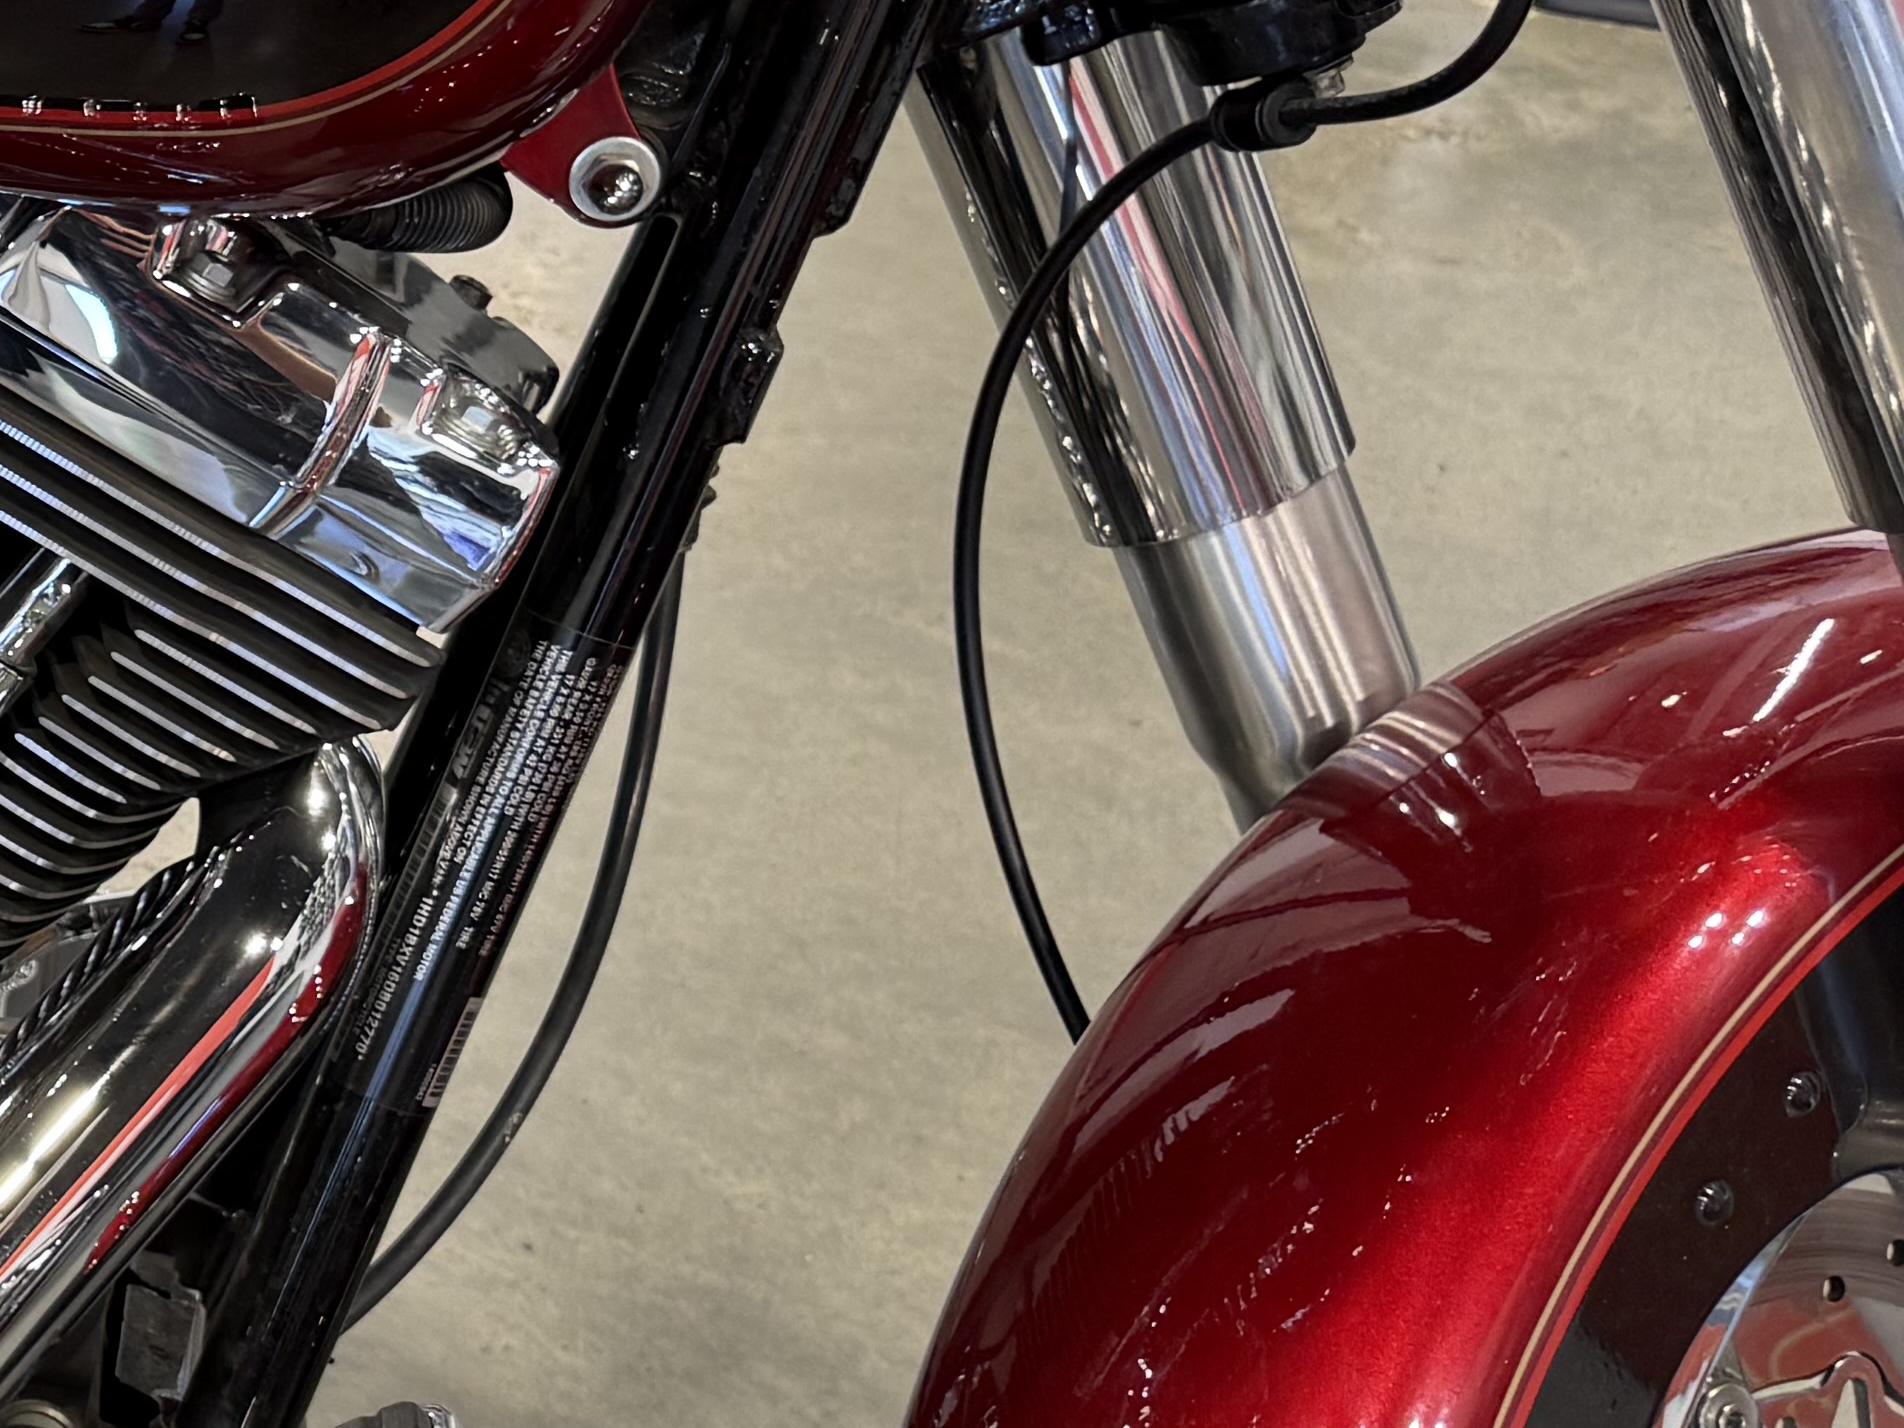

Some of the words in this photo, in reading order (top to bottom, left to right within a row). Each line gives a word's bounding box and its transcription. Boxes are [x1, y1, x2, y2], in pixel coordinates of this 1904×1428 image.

[531, 639, 548, 659] THE
[553, 649, 573, 673] THIS
[517, 660, 538, 688] DATE
[532, 643, 561, 688] VEHICLE
[562, 673, 576, 685] 17
[510, 690, 524, 705] OF
[512, 688, 540, 729] SAFETY
[532, 672, 562, 718] VEHICLE
[473, 705, 517, 783] MANUFACTURE
[504, 717, 540, 778] CONFORMS
[531, 738, 546, 753] AT
[541, 744, 557, 761] KG
[555, 745, 569, 759] AT
[483, 729, 521, 793] STANDARDS
[497, 779, 512, 794] TO
[516, 767, 532, 784] PSI
[456, 784, 481, 823] SHOWN
[478, 793, 492, 805] IN
[487, 795, 506, 815] ALL
[502, 785, 524, 815] COLD
[526, 792, 548, 822] COLD
[459, 805, 487, 845] EFFECT
[509, 803, 530, 830] WITH
[439, 823, 464, 858] ABOVE
[452, 846, 468, 863] ON
[459, 816, 496, 879] APPLICABLE
[429, 895, 460, 942] FEDERAL
[454, 924, 474, 949] TIRE
[411, 942, 438, 980] MOTOR
